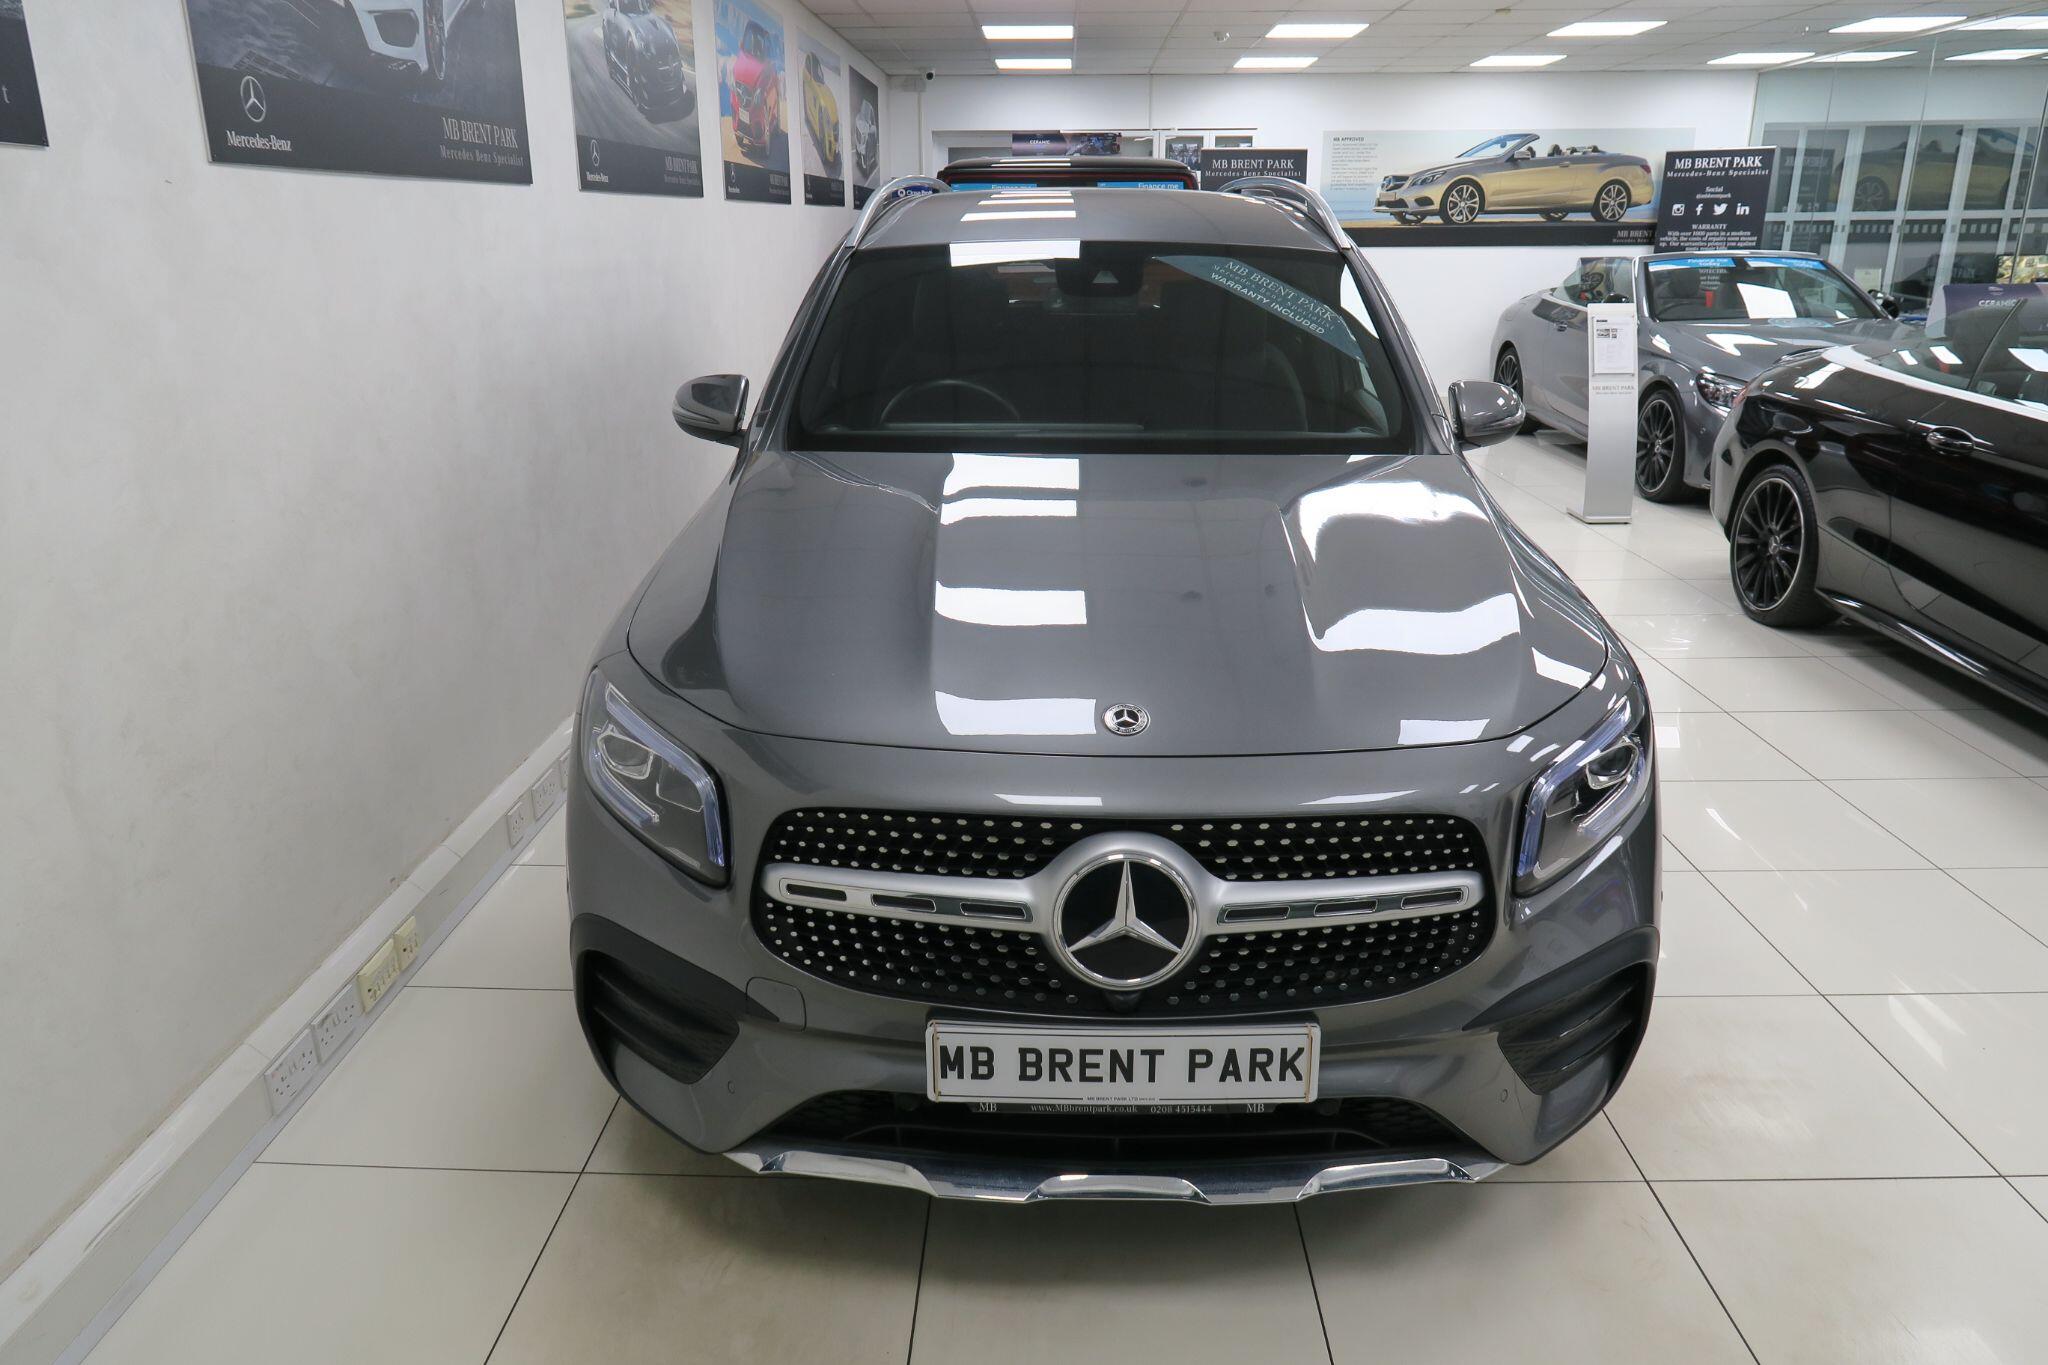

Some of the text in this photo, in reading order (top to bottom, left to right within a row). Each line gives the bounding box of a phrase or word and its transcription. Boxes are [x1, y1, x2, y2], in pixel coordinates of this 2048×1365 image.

[226, 129, 293, 152] Mercedes-Benz
[442, 116, 518, 149] MB BRENT PARK
[440, 144, 524, 167] Mercedes Benz Specialist
[1212, 159, 1295, 169] MB BRENT PARK
[1675, 155, 1763, 170] MB BRENT PARK
[1667, 168, 1769, 178] Mercedes-Benz Specialist
[1225, 261, 1336, 321] MB BRENT PARK
[1211, 272, 1325, 334] WARRANTY INCLUDED
[940, 1045, 1304, 1083] MB BRENT PARK
[979, 1102, 997, 1113] MB
[1030, 1103, 1138, 1114] www.MBbrentpark.co.uk
[1175, 1104, 1213, 1113] 4515444
[1246, 1102, 1265, 1114] MB
